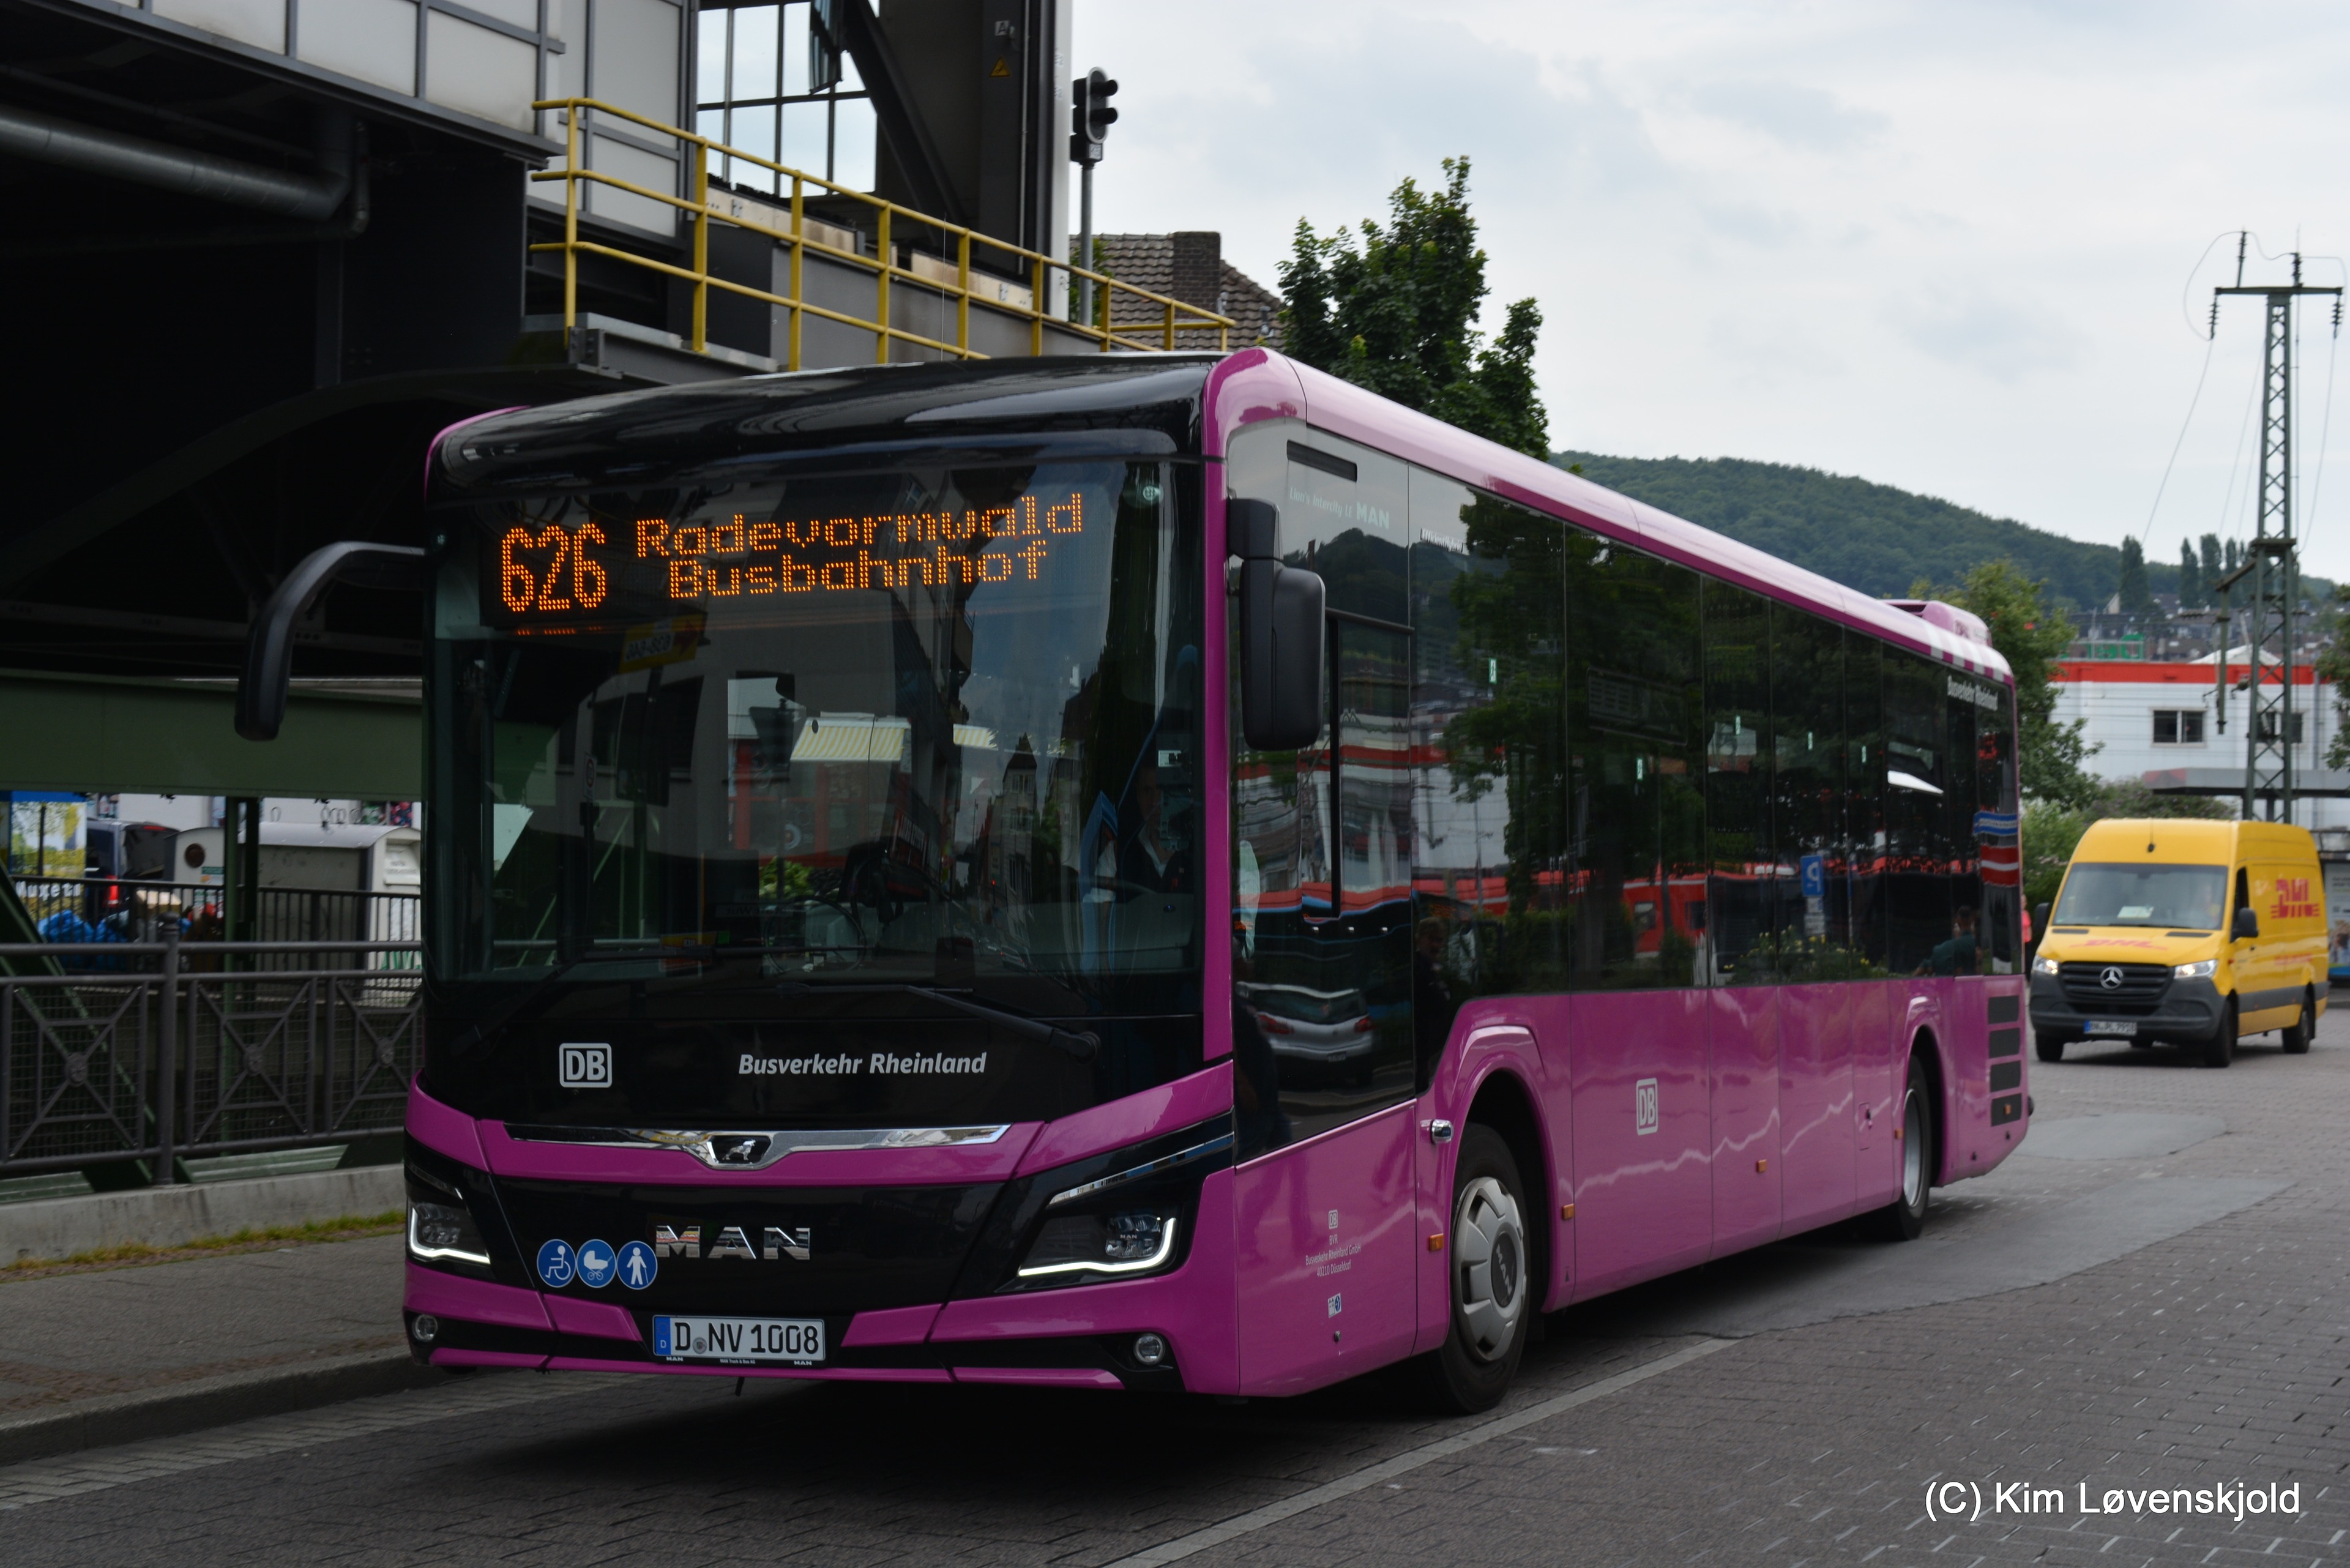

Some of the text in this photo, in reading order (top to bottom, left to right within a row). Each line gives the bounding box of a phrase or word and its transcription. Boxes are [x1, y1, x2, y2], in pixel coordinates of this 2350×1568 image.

[1290, 487, 1389, 529] Lion's Intercity LE MAN
[636, 493, 1082, 558] Radevormwald
[501, 523, 607, 611] 626
[670, 540, 1046, 599] Busbahnhof
[565, 1049, 606, 1081] DB
[739, 1052, 987, 1075] Busverkehr Rheinland
[1639, 1085, 1655, 1128] DB
[1329, 1212, 1337, 1226] DB
[655, 1225, 810, 1260] MAN
[1305, 1243, 1361, 1266] Busverkehr Rheinland GmbH
[1329, 1234, 1338, 1245] BVR
[1317, 1259, 1351, 1277] 40210 Düsseldorf
[1496, 1243, 1513, 1295] MAN
[660, 1340, 666, 1348] D
[674, 1322, 819, 1354] D NV 1008
